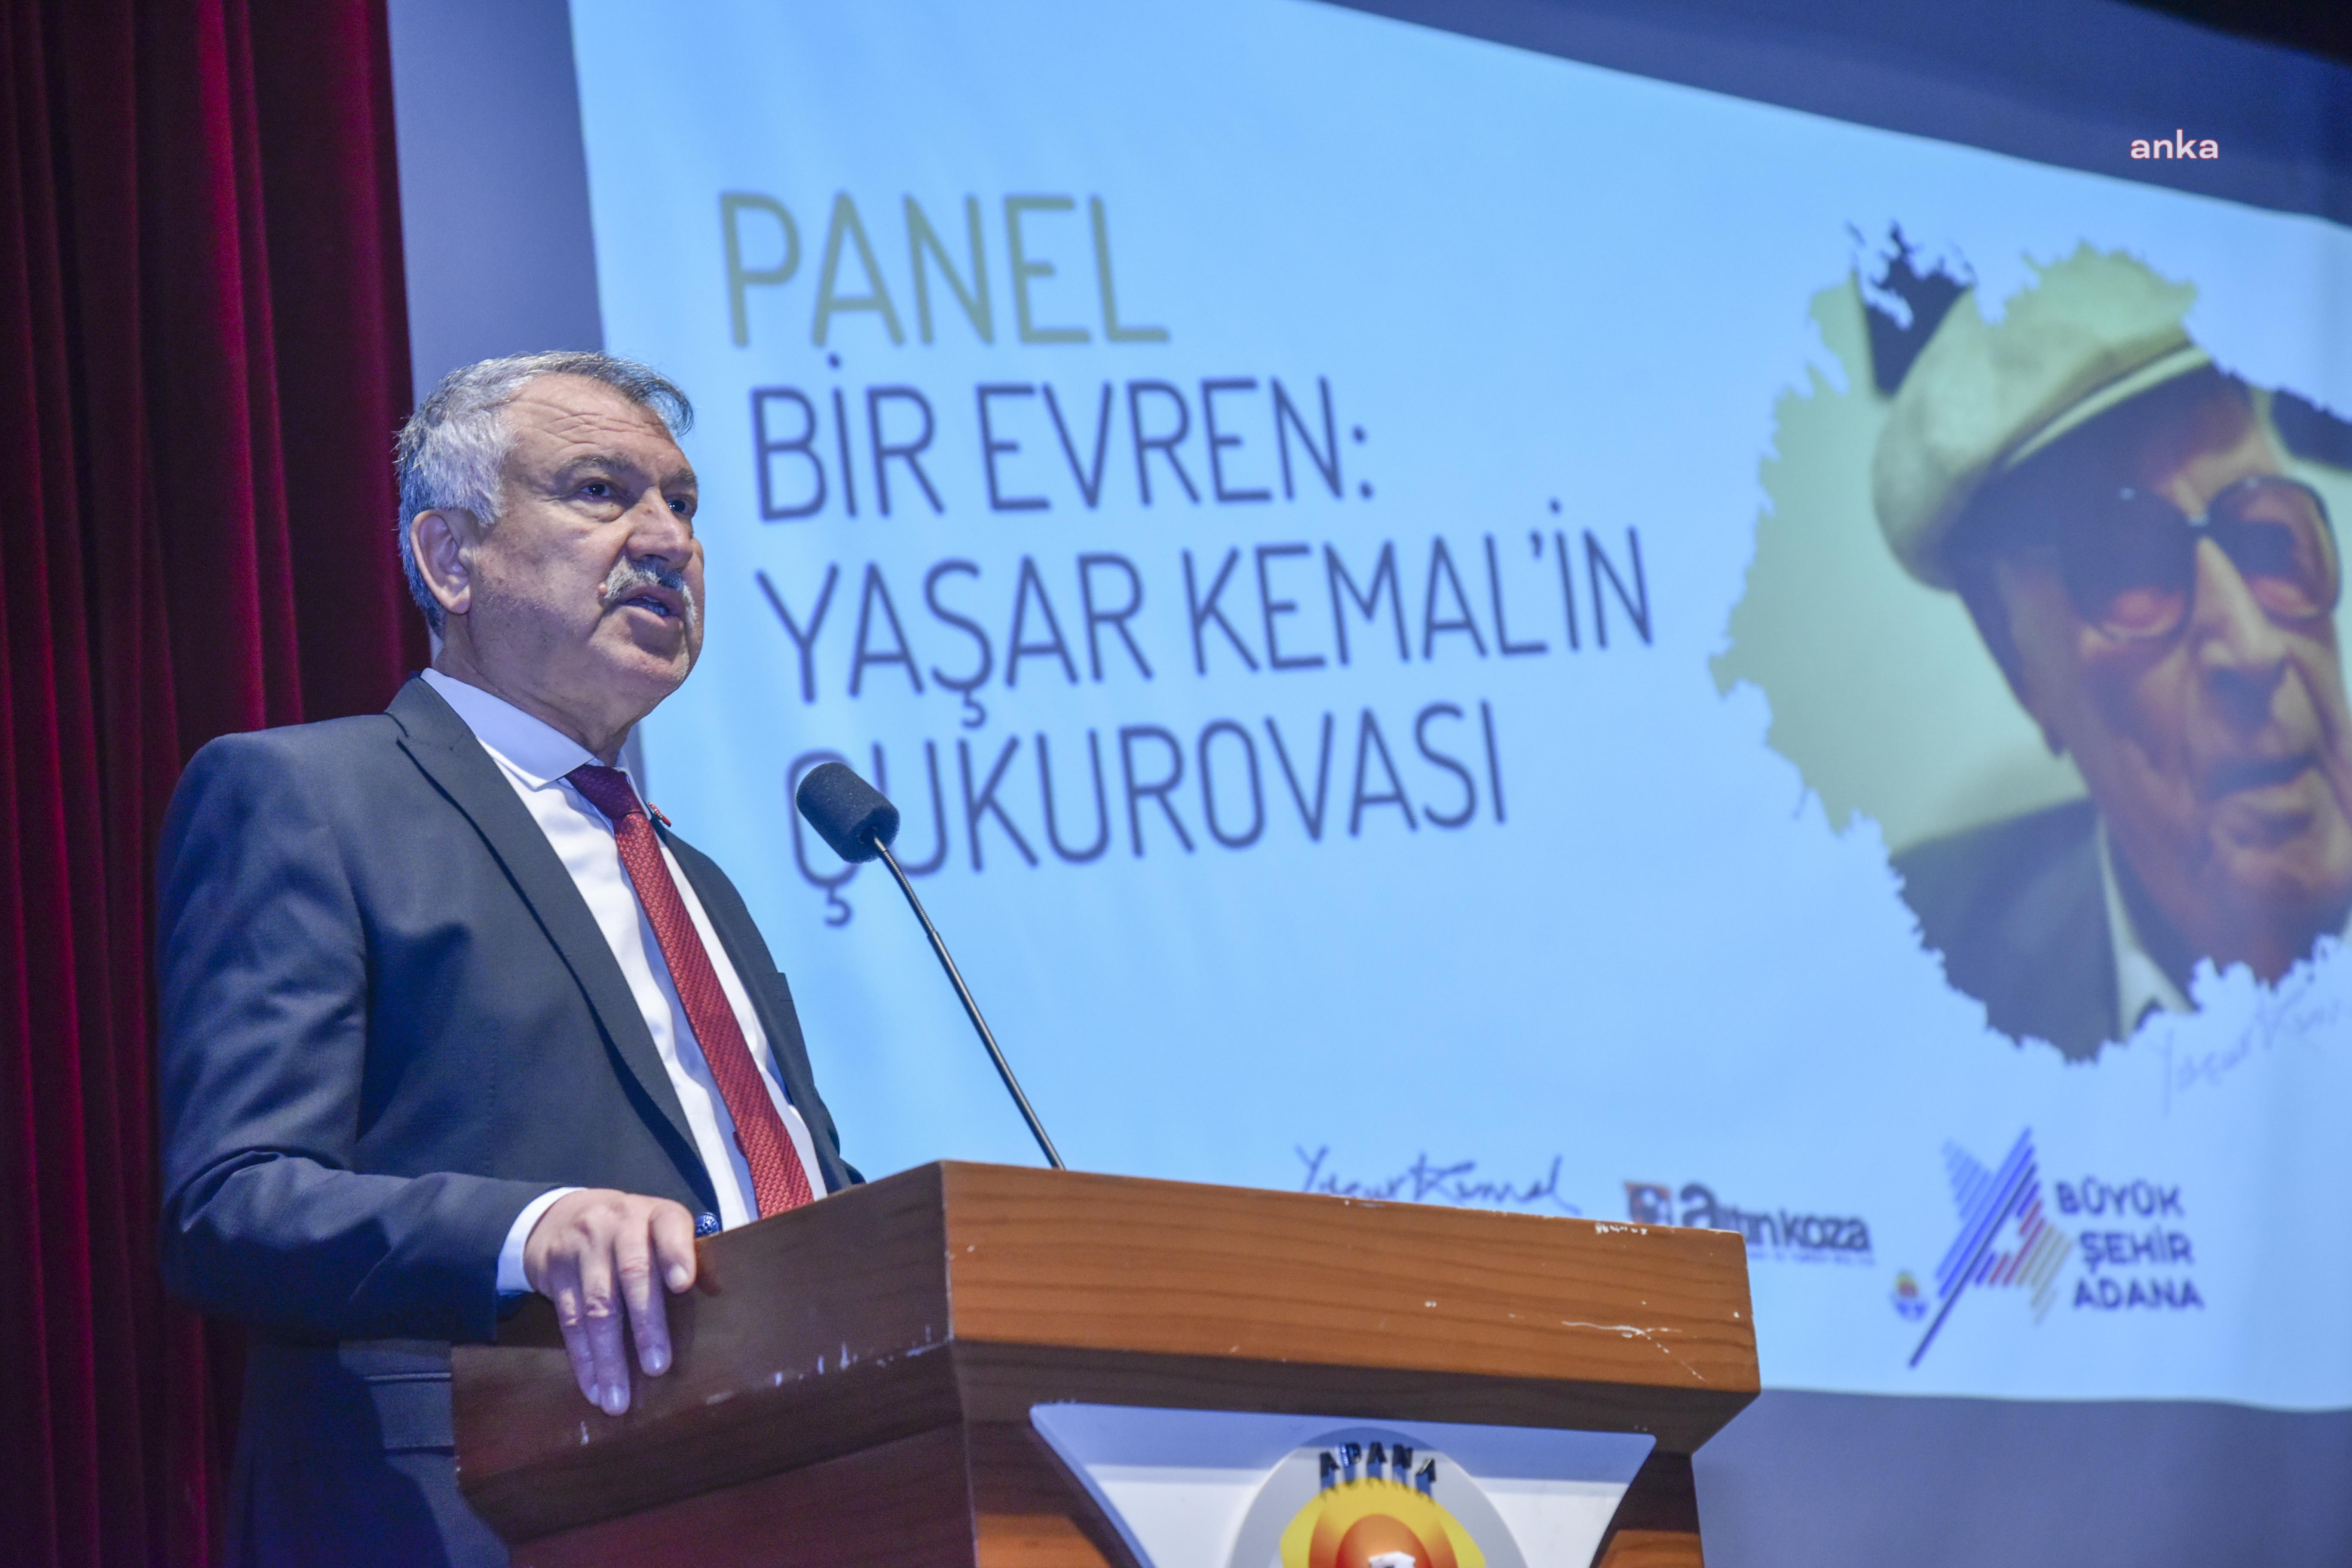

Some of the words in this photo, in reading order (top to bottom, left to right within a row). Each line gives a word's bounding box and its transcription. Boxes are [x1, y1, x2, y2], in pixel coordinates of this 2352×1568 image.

[719, 190, 1170, 347] PANEL
[750, 352, 944, 522] BİR
[975, 374, 1373, 511] EVREN:
[756, 552, 1154, 729] YAŞAR
[785, 698, 1506, 928] ÇUKUROVASI
[2056, 1176, 2185, 1218] BÜYÜK
[2079, 1225, 2195, 1274] ŞEHİR
[2073, 1277, 2206, 1311] ADANA
